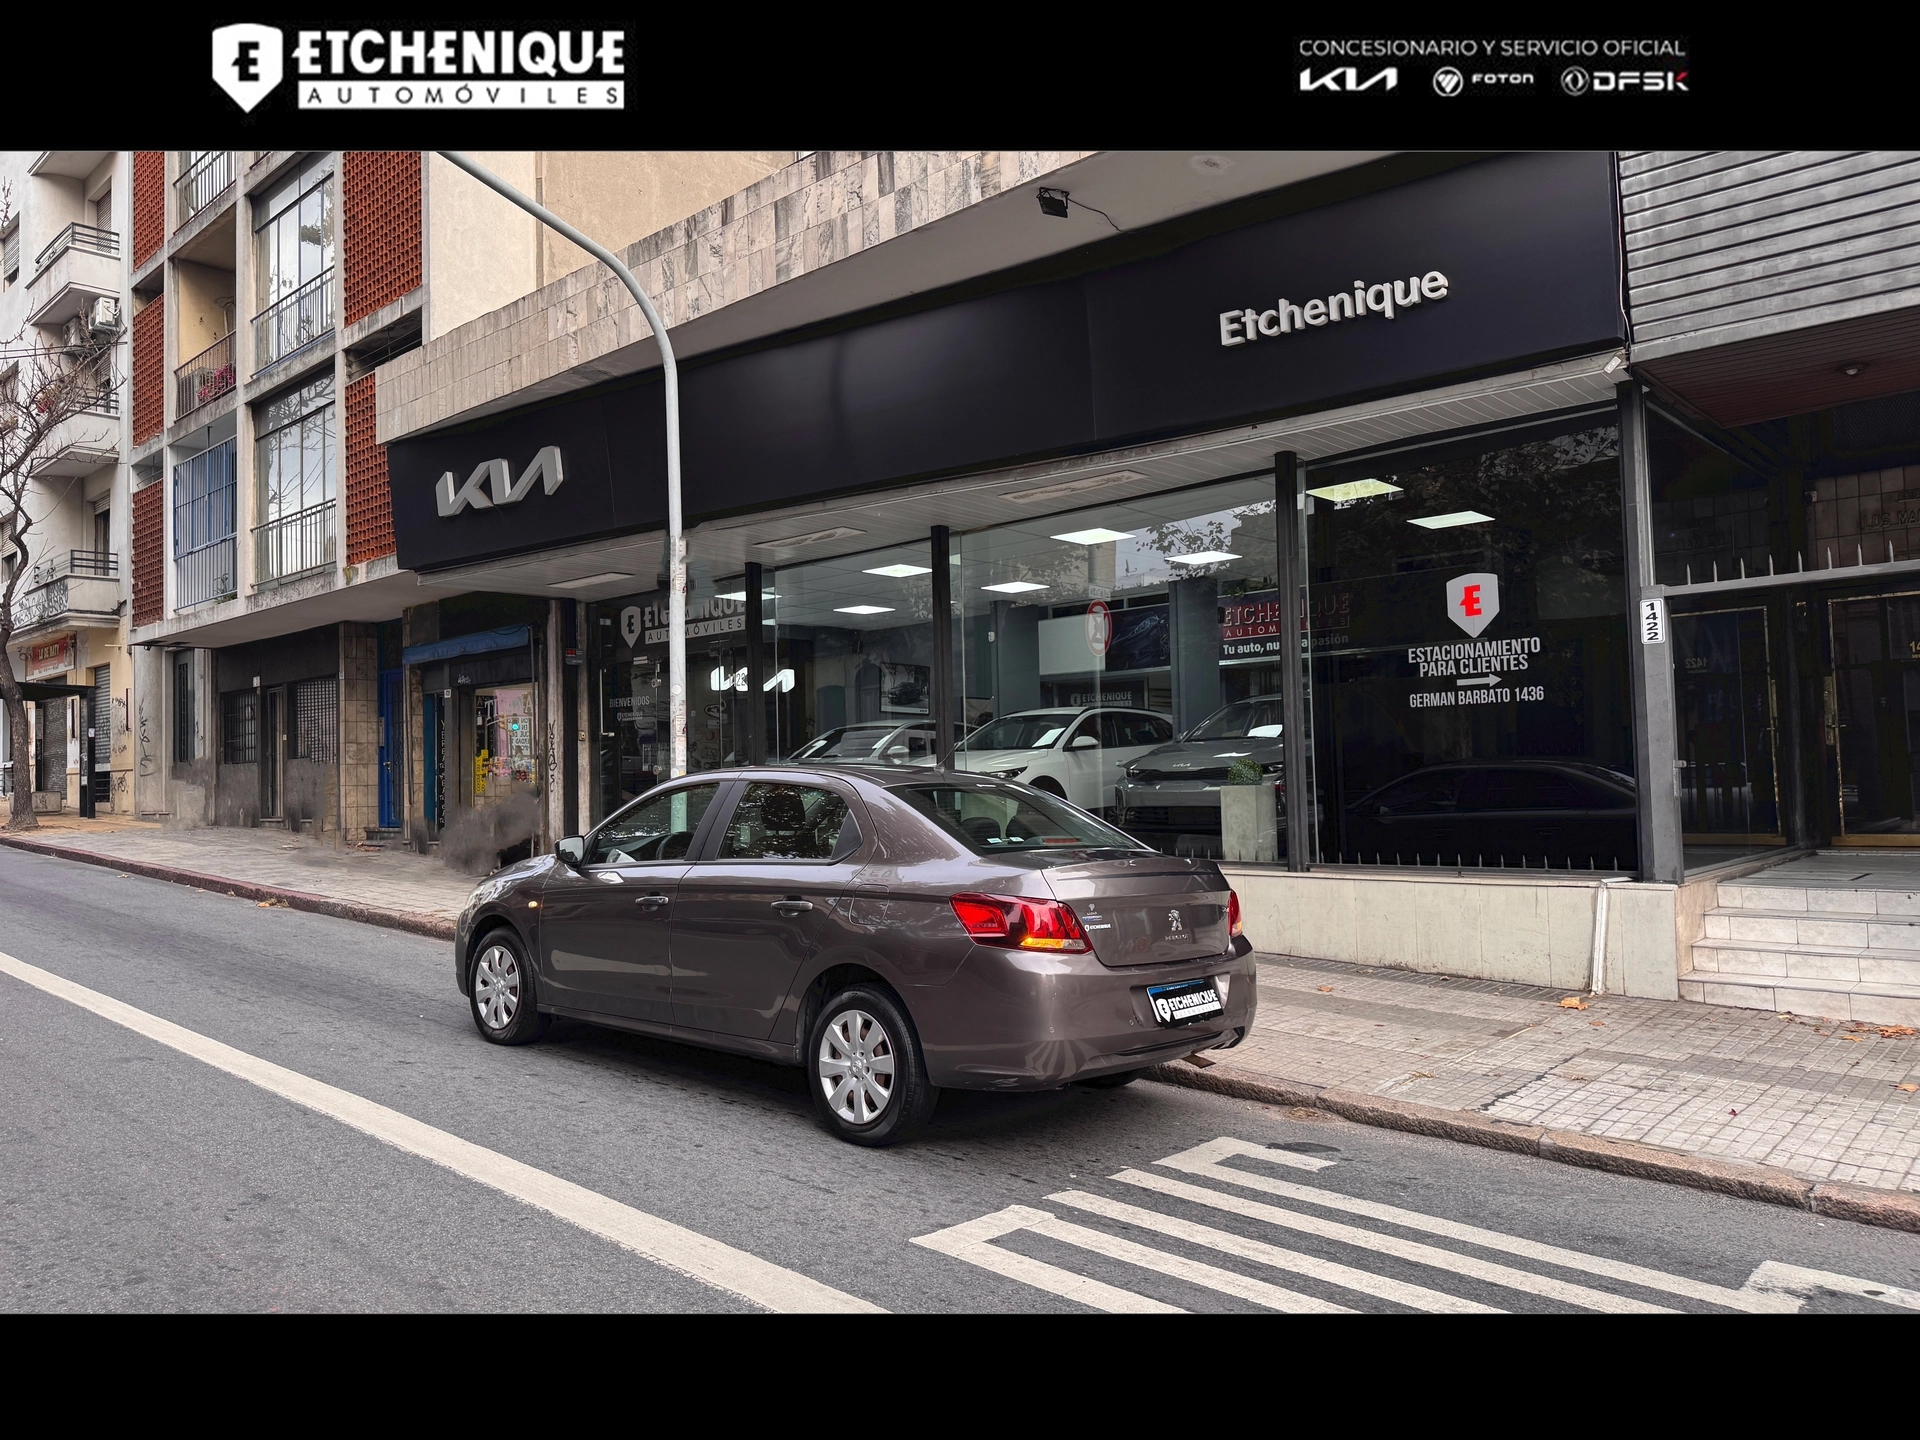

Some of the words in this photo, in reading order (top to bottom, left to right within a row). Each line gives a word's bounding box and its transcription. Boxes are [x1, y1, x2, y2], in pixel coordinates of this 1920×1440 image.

[1219, 270, 1449, 346] Etchenique
[435, 445, 564, 518] KIA
[1645, 602, 1659, 641] 1422
[1223, 644, 1235, 655] Tu
[1237, 642, 1264, 654] auto,
[1312, 633, 1349, 649] pasión
[1408, 636, 1541, 664] ESTACIONAMIENTO
[1419, 660, 1457, 678] PARA
[1460, 654, 1528, 675] CLIENTES
[710, 666, 795, 693] KA
[610, 696, 650, 708] BIENVENIDOS
[1082, 691, 1132, 702] ETCHENIQUE
[1409, 691, 1455, 708] GERMAN
[1458, 688, 1510, 705] BARBATO
[1514, 686, 1544, 702] 1436
[1168, 988, 1218, 1010] ETCHENIQUE
